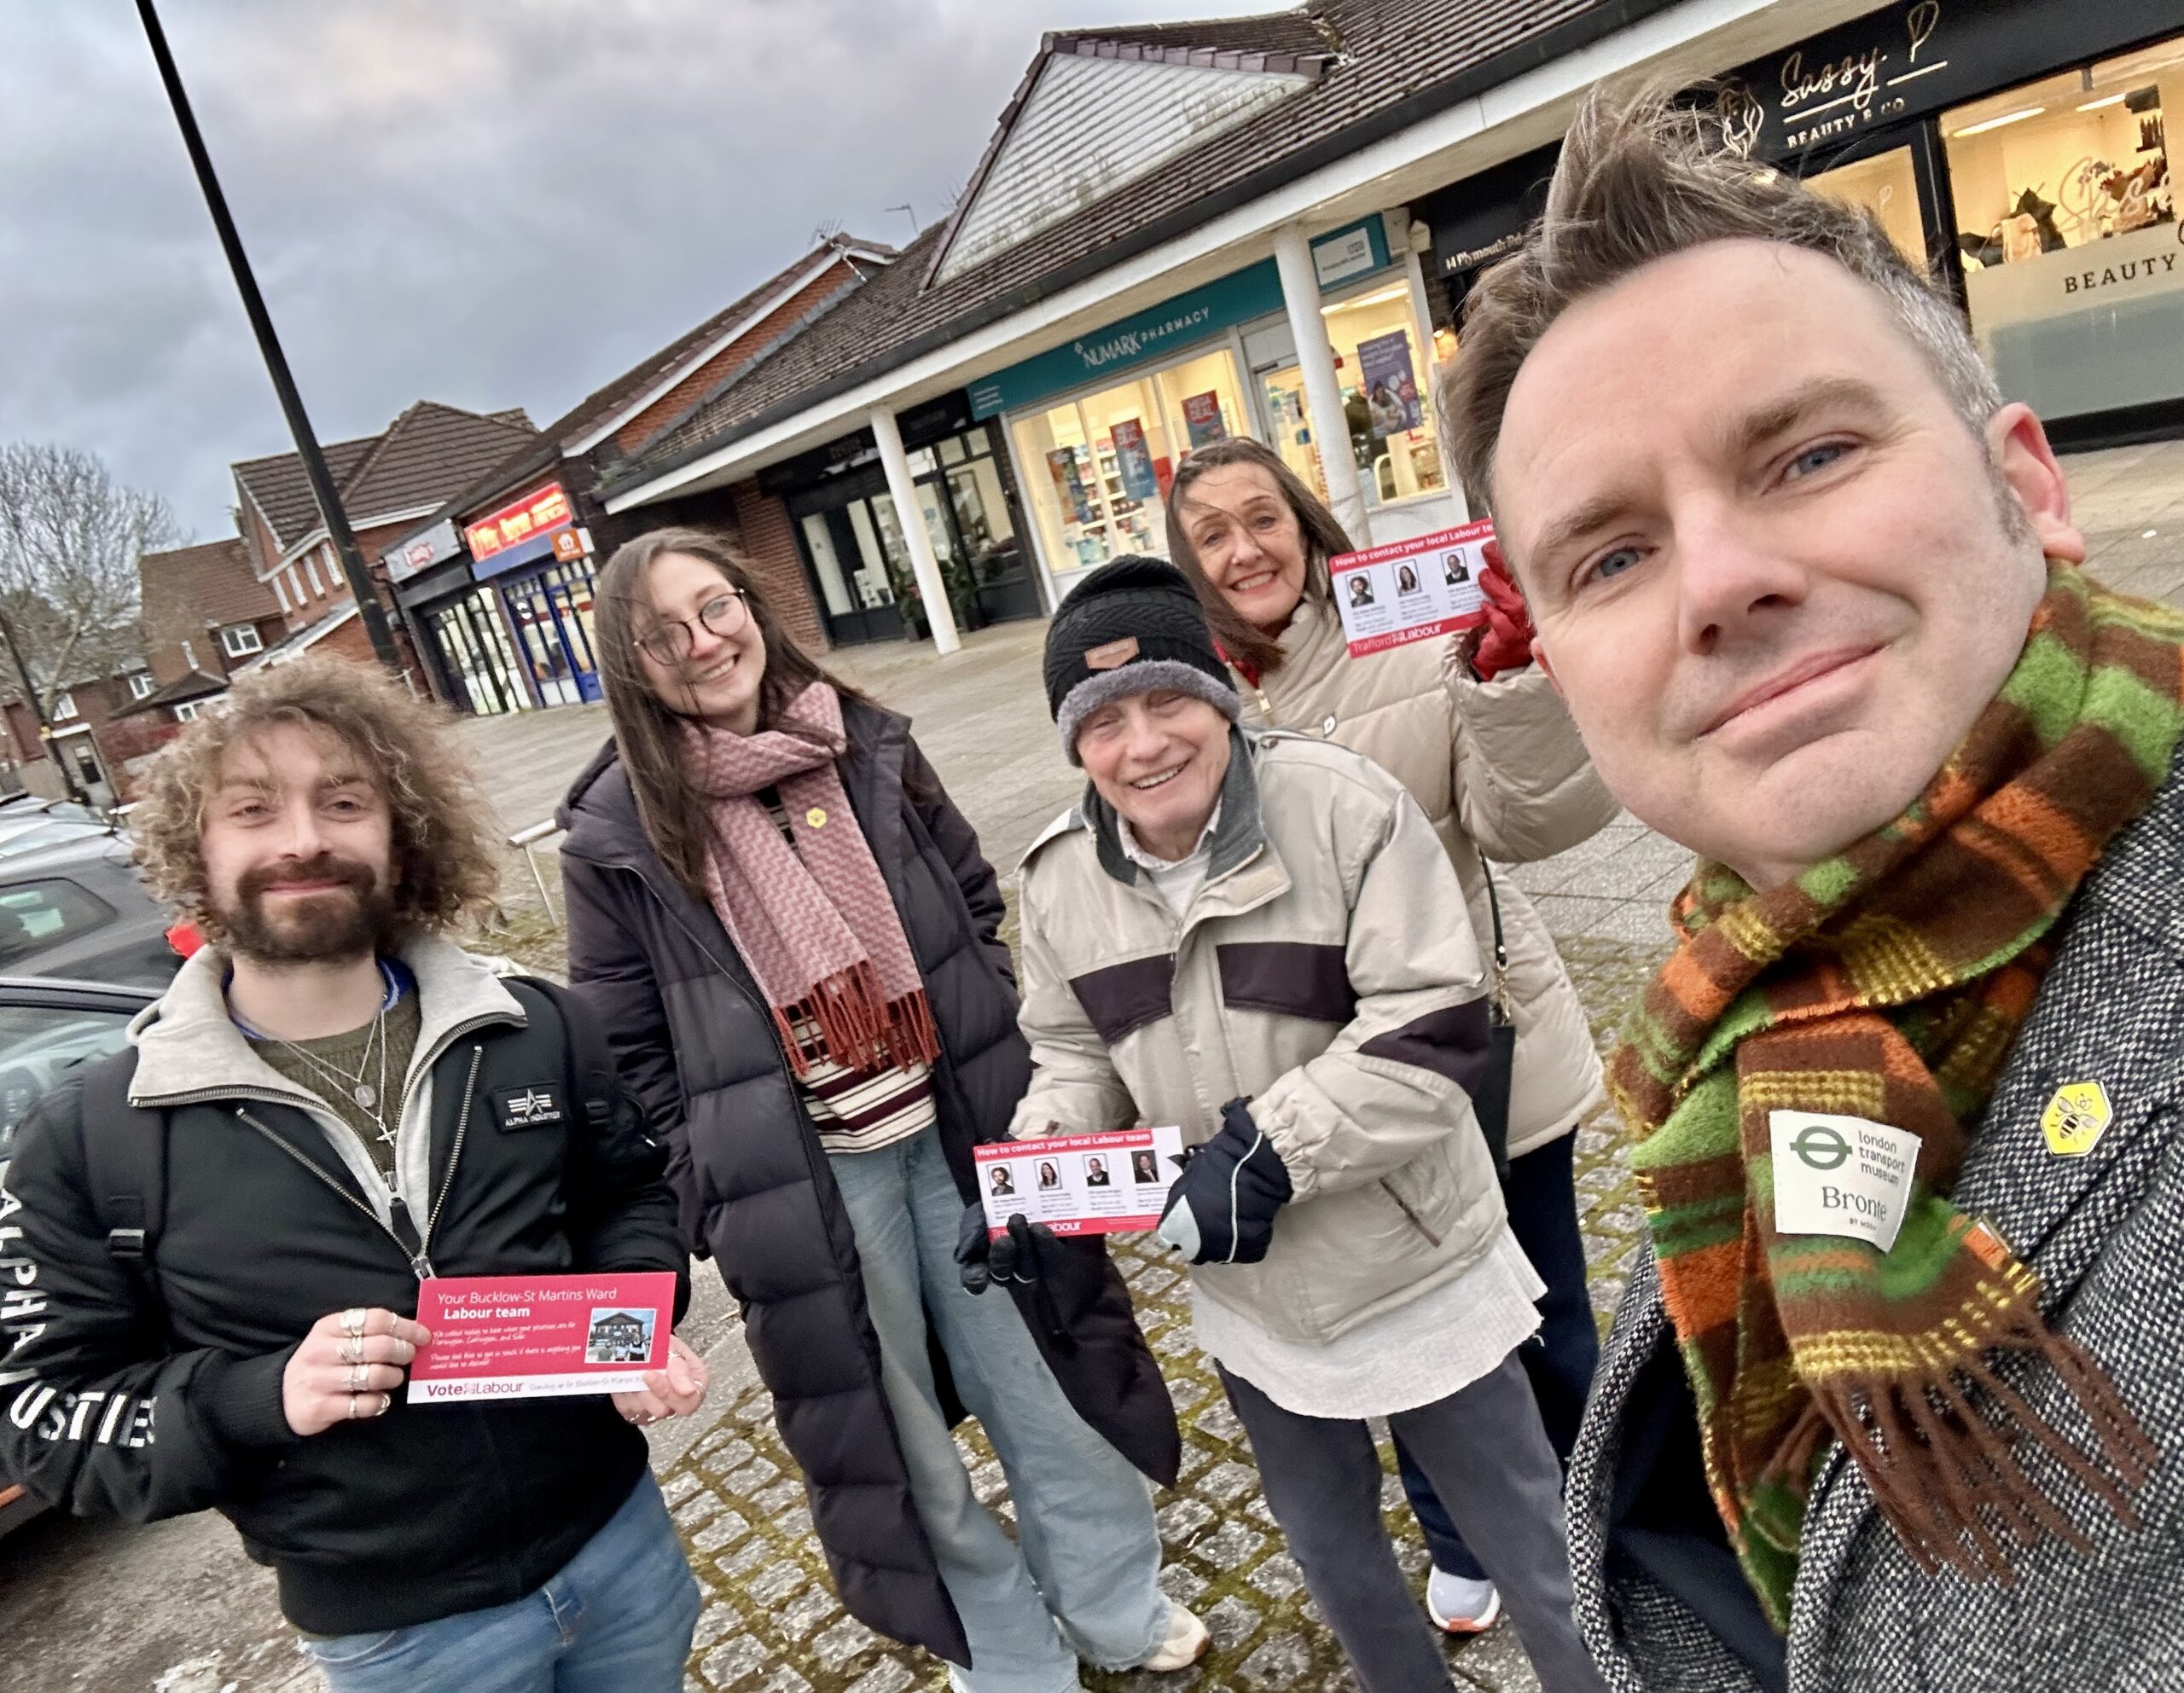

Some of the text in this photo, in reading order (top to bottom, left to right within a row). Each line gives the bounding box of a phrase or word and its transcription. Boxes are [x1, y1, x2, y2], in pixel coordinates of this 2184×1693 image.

[1787, 114, 1855, 149] BEAUTY
[1880, 97, 1905, 115] CO
[2064, 253, 2177, 293] BEAUTY
[1141, 307, 1209, 343] PHARMACY
[1335, 557, 1356, 567] How
[1357, 554, 1368, 563] to
[1368, 546, 1403, 560] contact
[1404, 541, 1425, 554] your
[1426, 533, 1448, 546] local
[1449, 525, 1481, 540] Labour
[1353, 623, 1443, 652] Trafford Labour
[978, 1148, 998, 1157] How
[1011, 1142, 1046, 1153] contact
[1047, 1140, 1067, 1151] your
[1069, 1136, 1091, 1146] local
[1092, 1135, 1124, 1144] Labour
[1125, 1133, 1150, 1142] team
[1859, 1130, 1896, 1154] london
[1859, 1146, 1905, 1173] transport
[1861, 1162, 1899, 1186] museum
[1048, 1220, 1082, 1232] abour
[438, 1287, 618, 1305] Your Bucklow-St Martins Ward
[444, 1307, 531, 1319] Labour team
[427, 1383, 462, 1397] Vote
[476, 1382, 524, 1394] Labour
